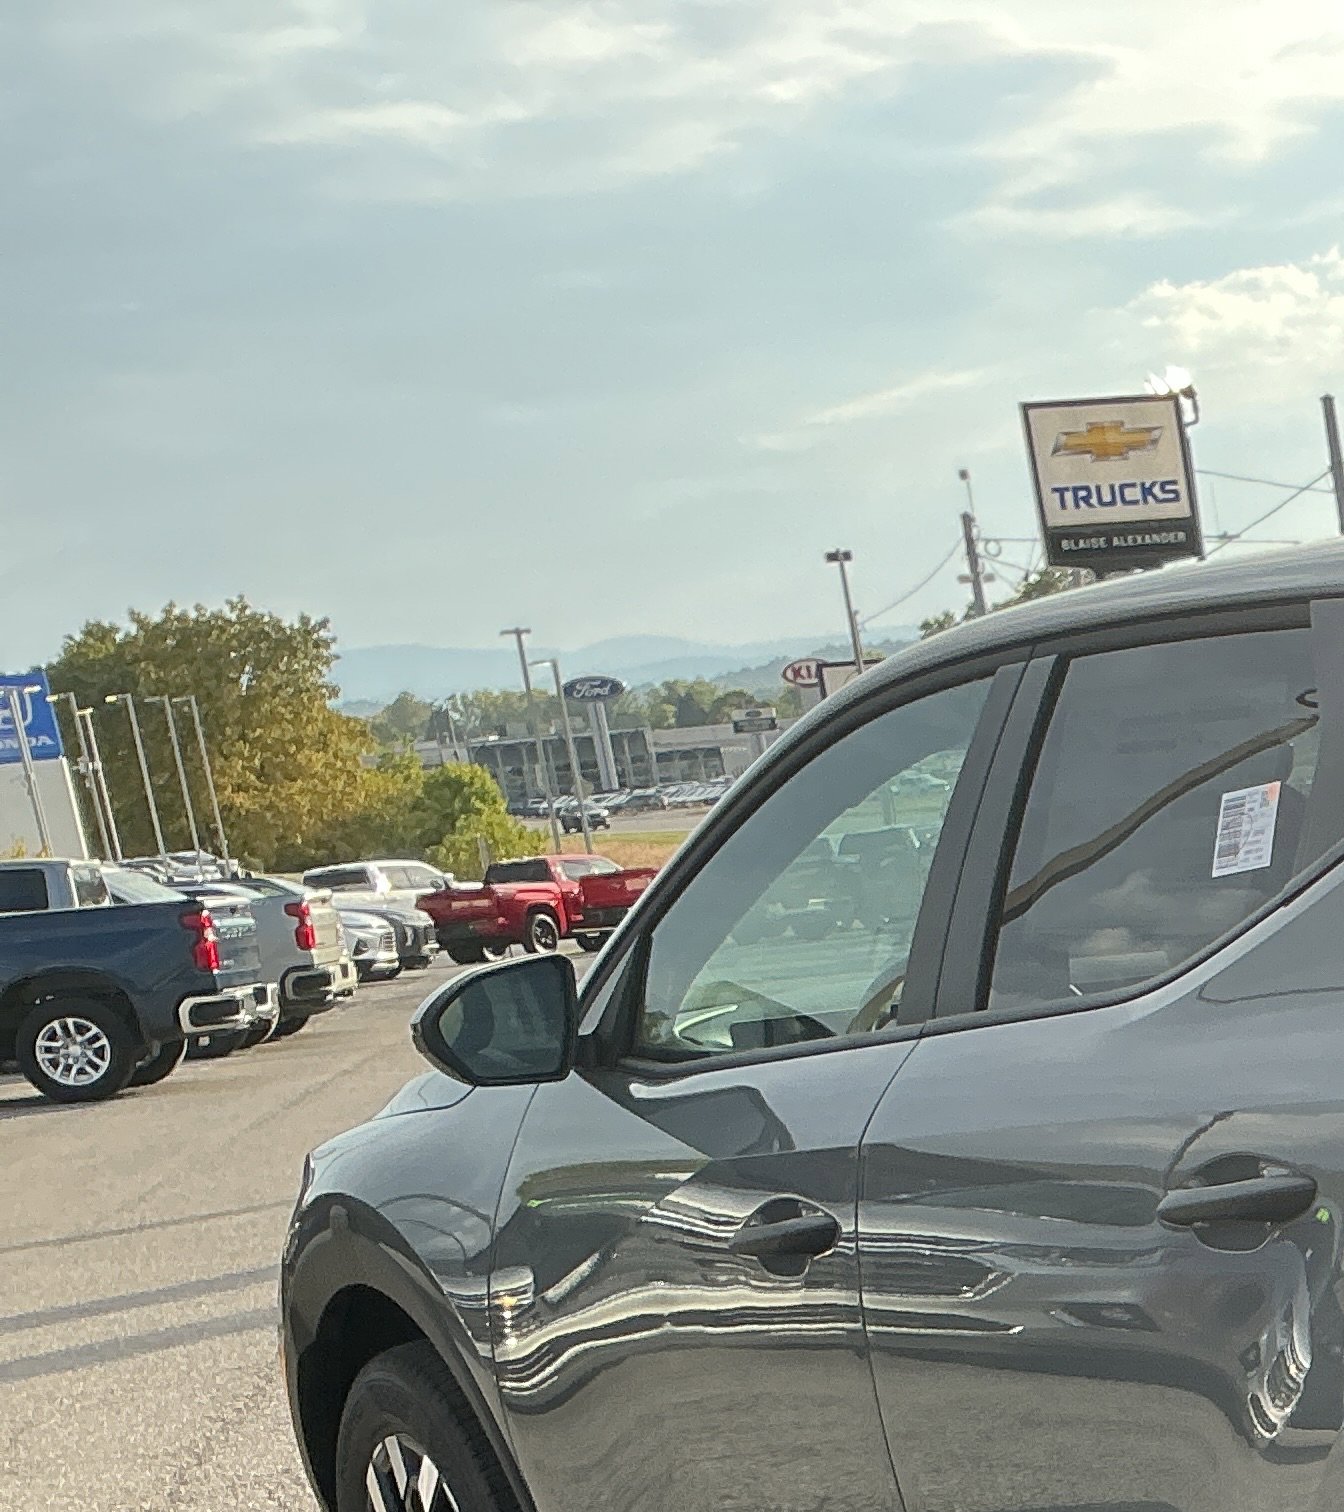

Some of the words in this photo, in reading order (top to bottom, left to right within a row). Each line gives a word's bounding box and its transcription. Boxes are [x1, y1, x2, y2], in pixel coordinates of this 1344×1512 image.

[1051, 479, 1181, 511] TRUCKS
[1060, 536, 1109, 552] BLAISE
[1112, 531, 1187, 547] ALEXANDER
[790, 664, 813, 682] KI
[573, 680, 612, 698] Ford
